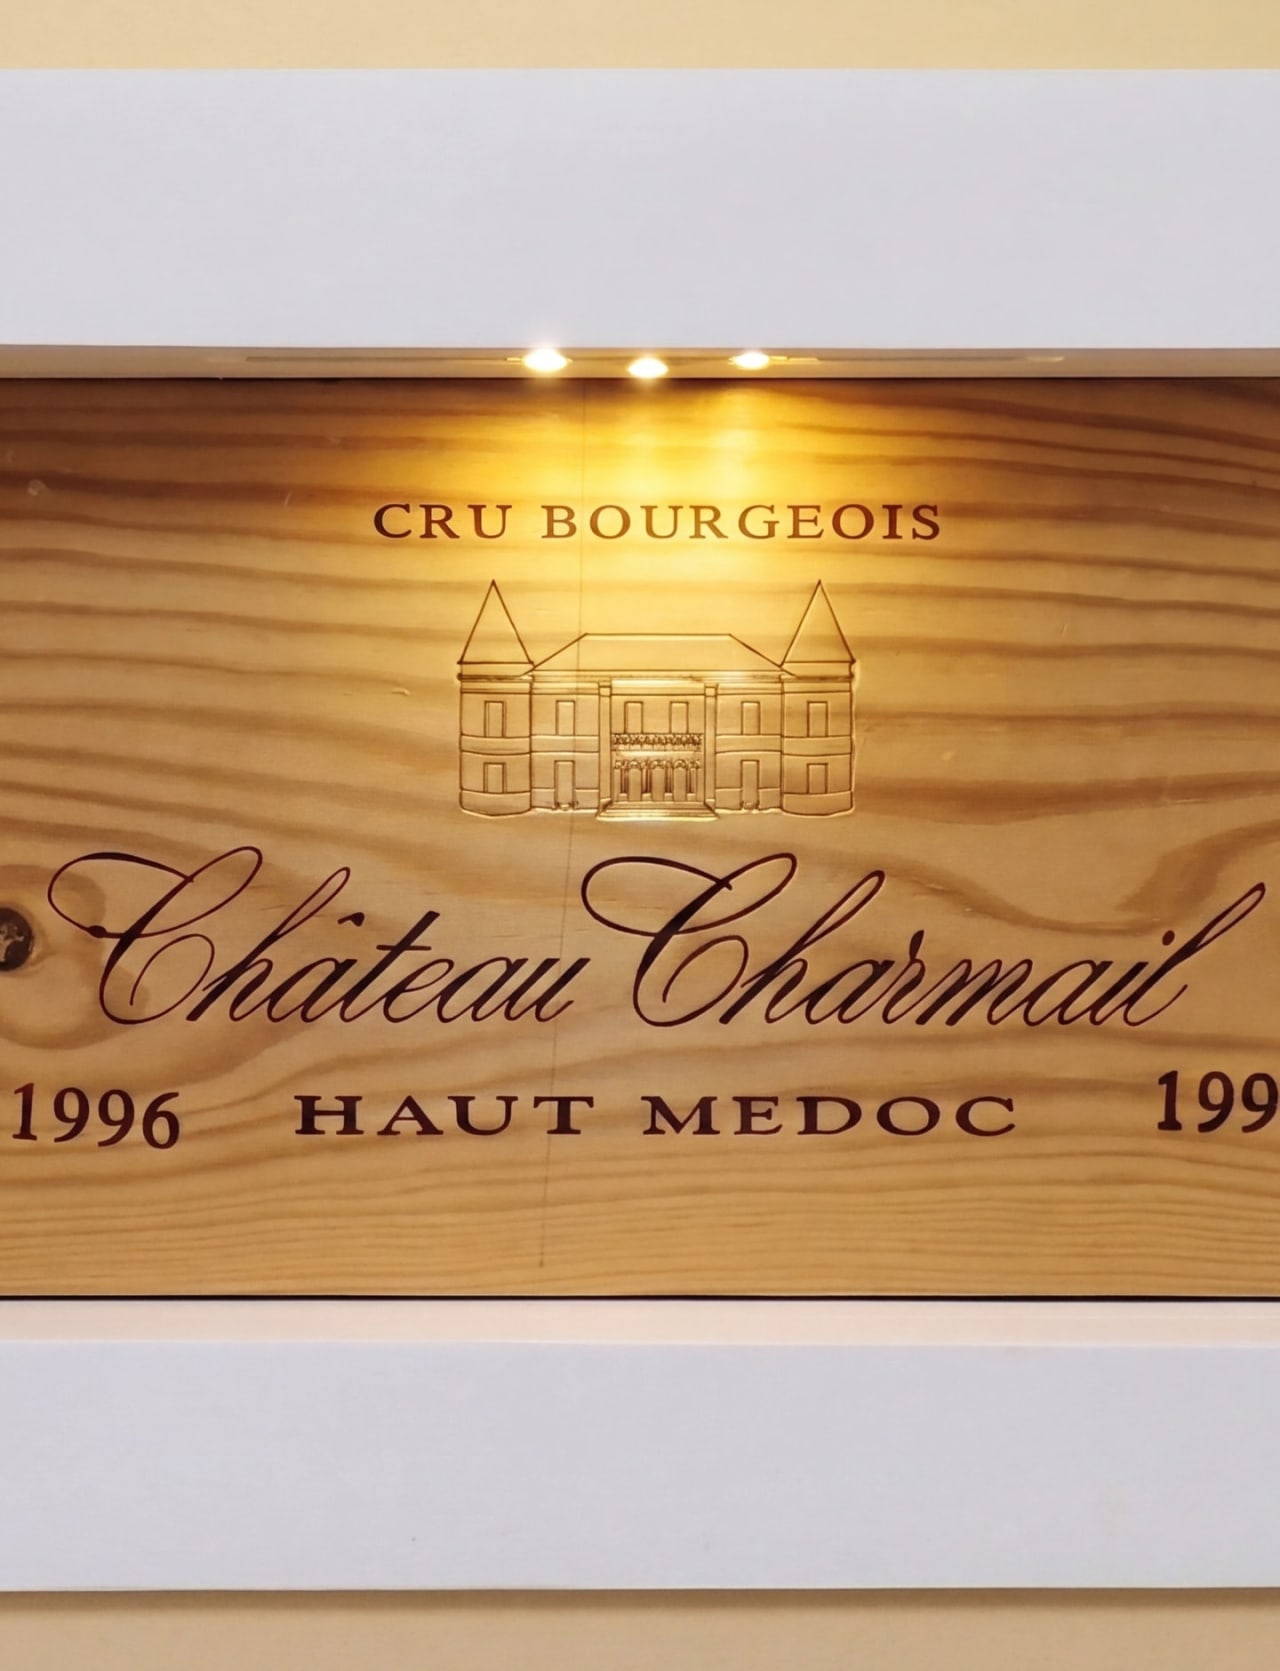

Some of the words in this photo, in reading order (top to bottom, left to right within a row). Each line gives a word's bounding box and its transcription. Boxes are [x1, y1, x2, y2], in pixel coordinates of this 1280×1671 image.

[373, 503, 512, 540] CRU
[541, 503, 942, 541] BOURGEOIS
[47, 846, 591, 1025] Château
[581, 852, 1266, 1028] Charmail
[12, 1082, 180, 1150] 1996
[294, 1095, 594, 1136] HAUT
[640, 1095, 1016, 1137] MEDOC
